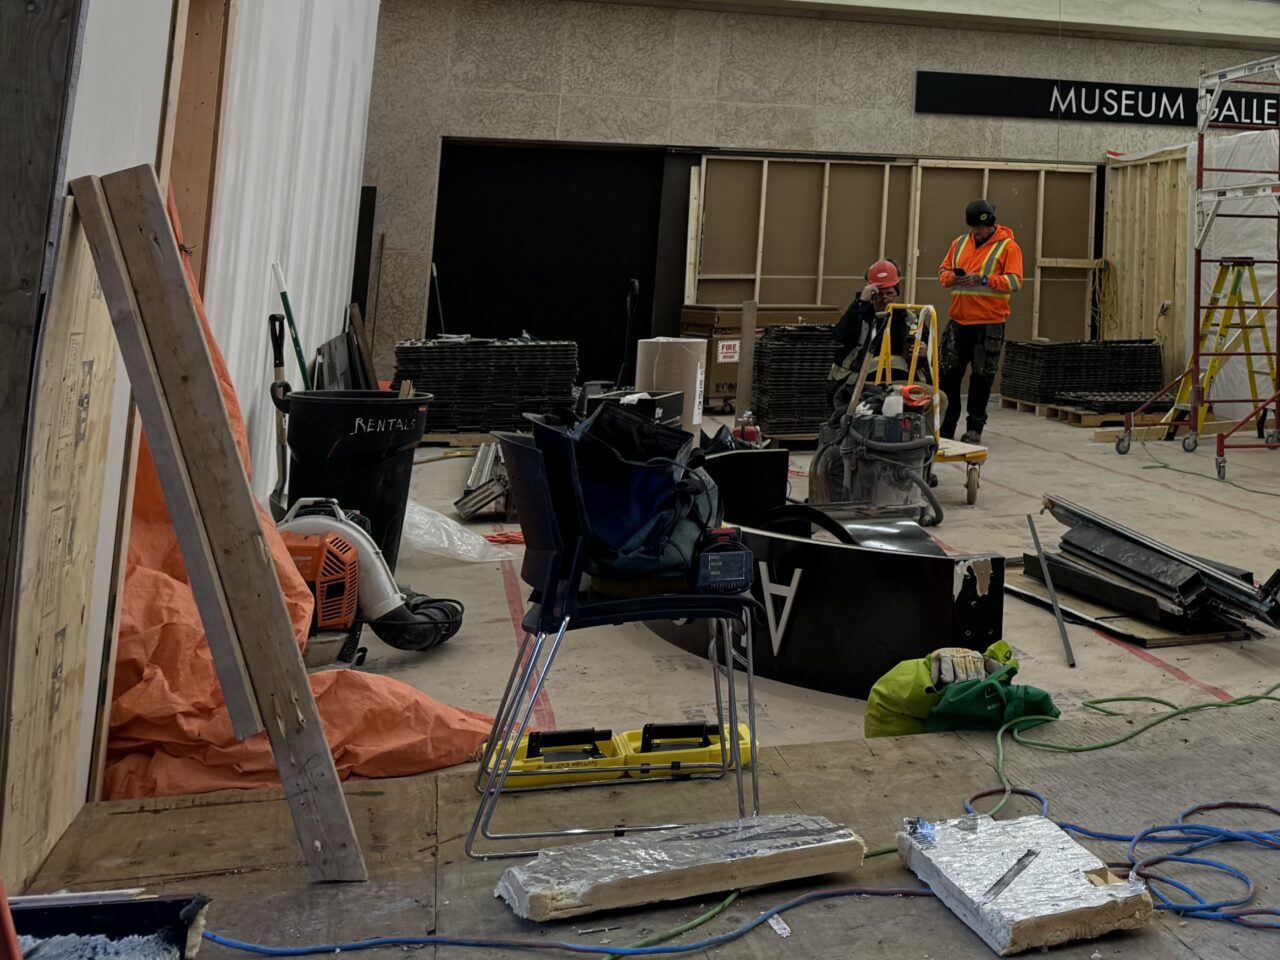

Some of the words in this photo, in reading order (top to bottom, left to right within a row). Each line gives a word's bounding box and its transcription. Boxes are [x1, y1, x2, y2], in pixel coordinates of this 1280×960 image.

[1049, 86, 1185, 119] MUSEUM
[721, 343, 737, 351] FIRE
[351, 417, 416, 435] RENTALS
